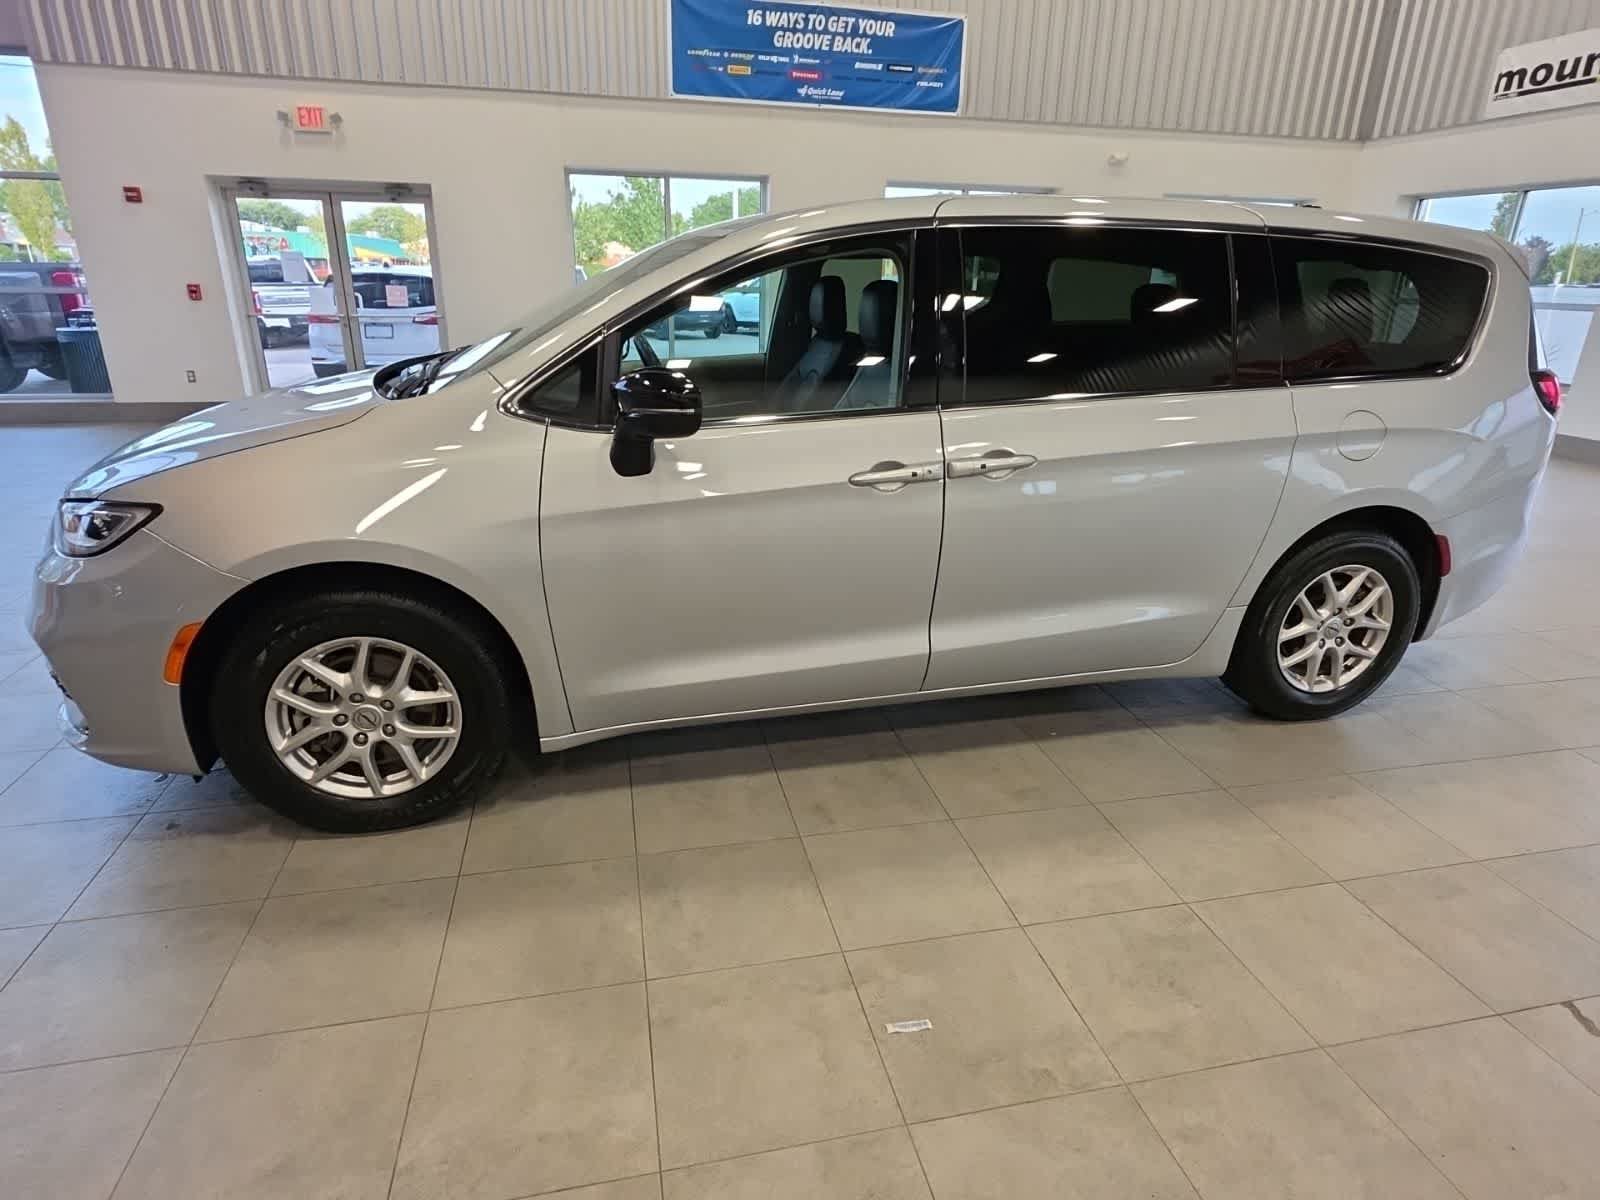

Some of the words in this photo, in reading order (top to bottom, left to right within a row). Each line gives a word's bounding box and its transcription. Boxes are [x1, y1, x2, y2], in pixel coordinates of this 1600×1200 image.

[746, 9, 762, 26] 16
[765, 10, 805, 30] WAYS
[808, 13, 825, 31] TO
[828, 15, 856, 33] GET
[858, 18, 895, 37] YOUR
[773, 30, 833, 51] GROOVE
[833, 36, 873, 54] BACK.
[297, 106, 326, 129] EXIT
